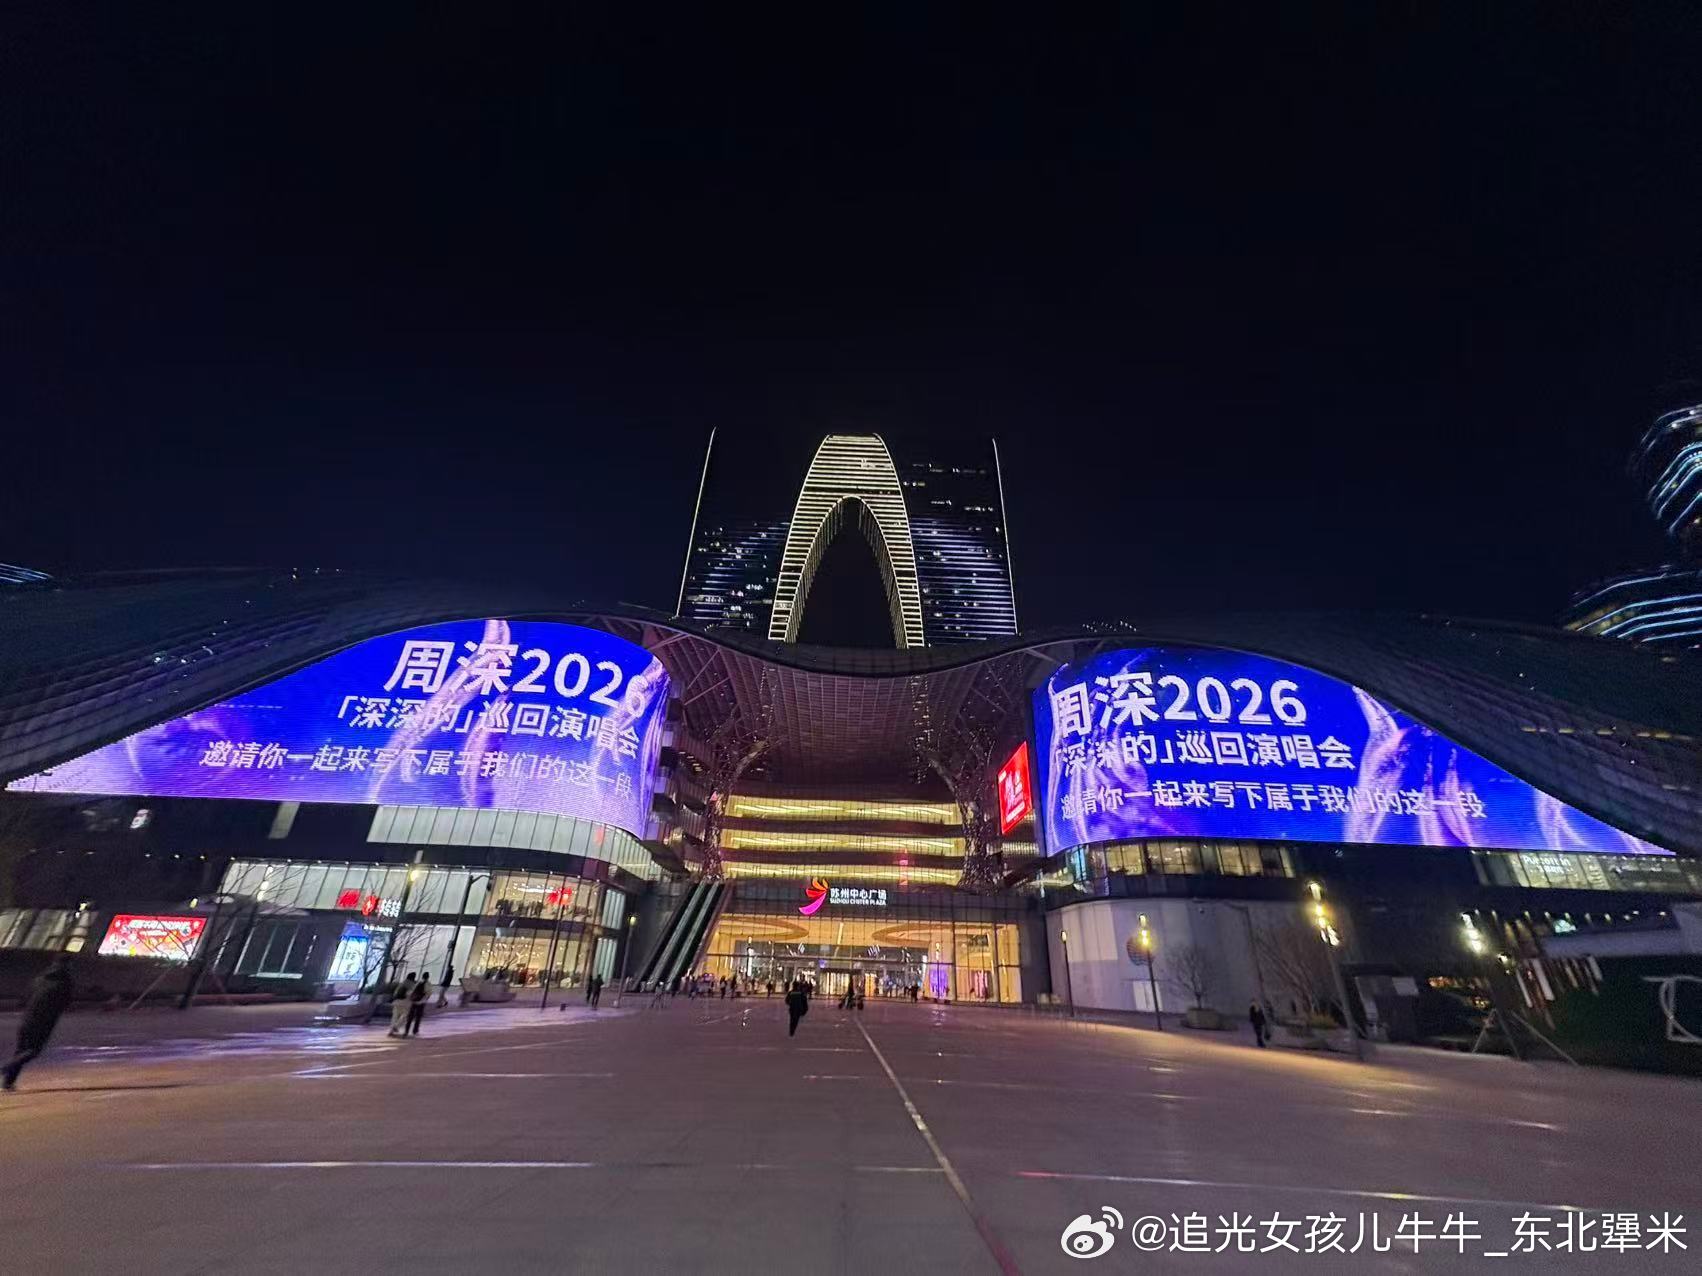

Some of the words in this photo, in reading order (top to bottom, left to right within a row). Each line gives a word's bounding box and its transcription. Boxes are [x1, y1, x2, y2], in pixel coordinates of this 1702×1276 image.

[384, 639, 646, 719] 周深2026
[1053, 671, 1308, 738] 周深2026
[337, 695, 640, 759] 「深深的」巡回演唱会
[199, 740, 634, 801] 邀请你一起来写下属于我们的这一段
[1060, 780, 1488, 821] 邀请你一起来写下属于我们的这一段
[830, 887, 887, 900] 苏州中心广场
